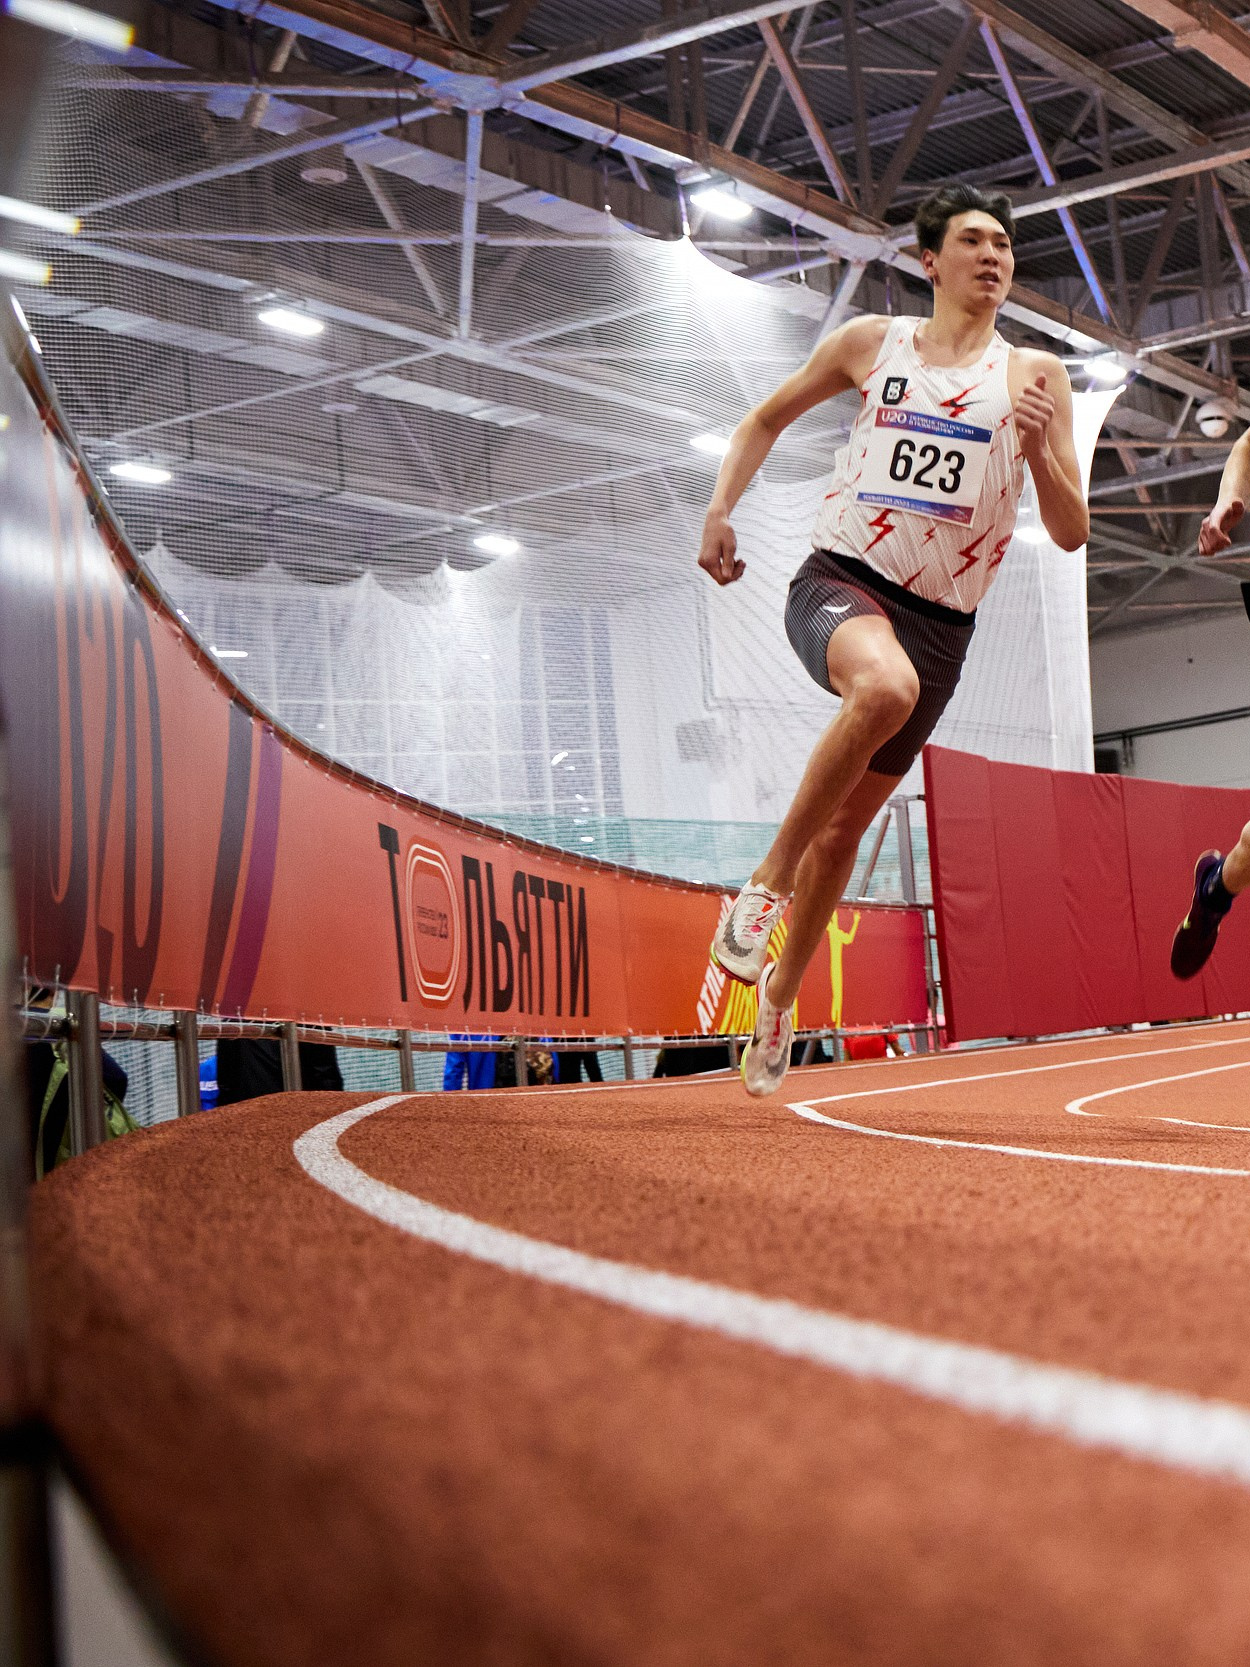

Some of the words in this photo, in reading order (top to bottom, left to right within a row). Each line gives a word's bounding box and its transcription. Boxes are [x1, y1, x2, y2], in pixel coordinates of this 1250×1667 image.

[881, 410, 907, 425] U20
[889, 438, 966, 494] 623
[377, 821, 590, 1018] ТОЛЬЯТТИ
